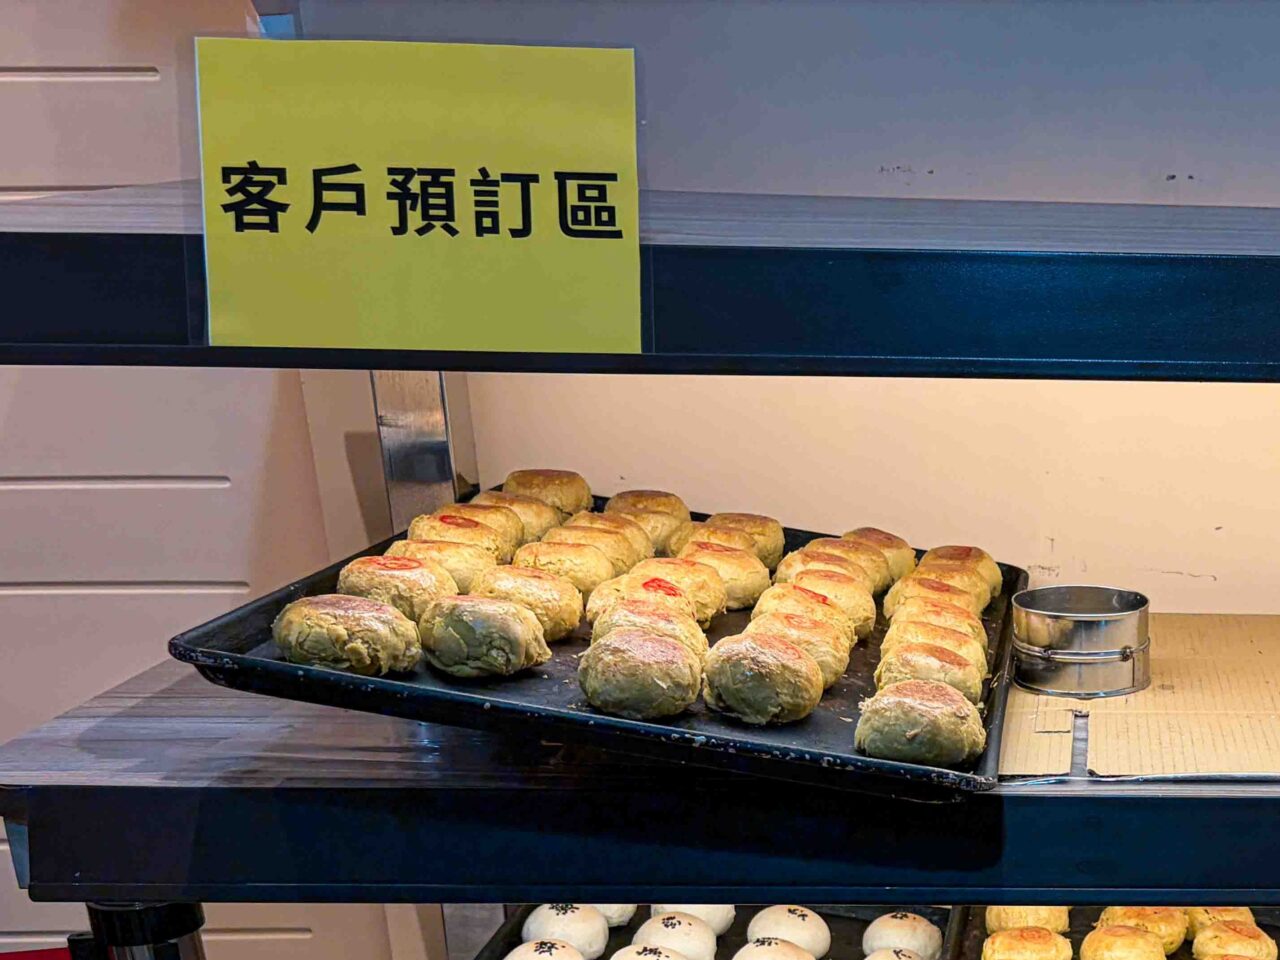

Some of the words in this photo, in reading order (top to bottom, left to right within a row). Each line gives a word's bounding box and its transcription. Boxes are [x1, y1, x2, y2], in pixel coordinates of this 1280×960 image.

[220, 160, 624, 240] 客戶預訂區
